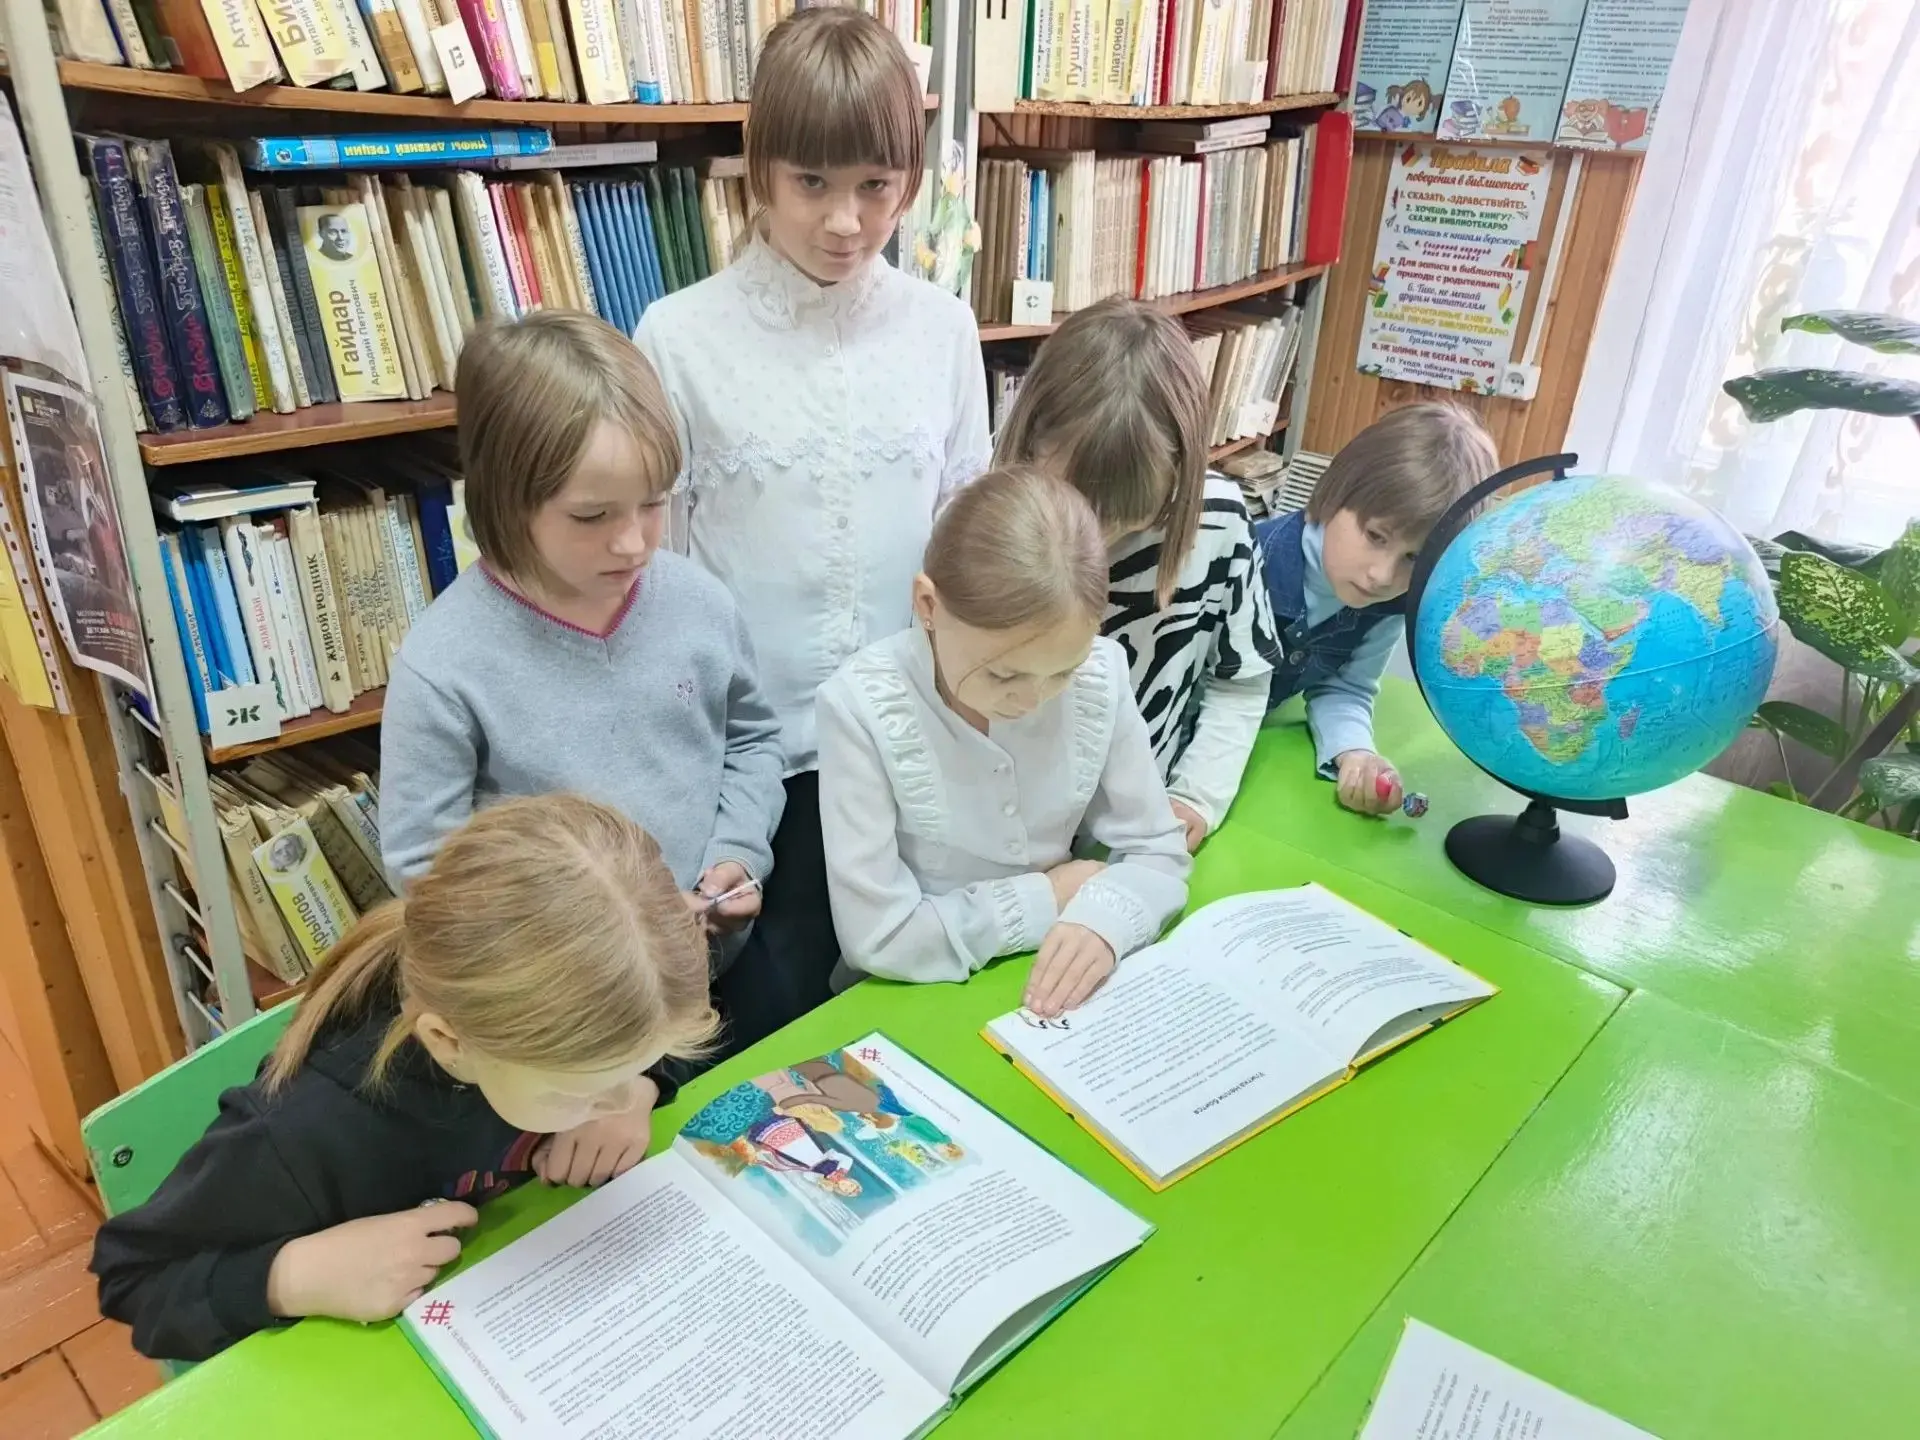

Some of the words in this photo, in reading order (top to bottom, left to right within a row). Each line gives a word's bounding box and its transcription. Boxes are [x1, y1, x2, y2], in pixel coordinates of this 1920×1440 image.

[270, 0, 307, 49] Би
[1066, 10, 1082, 85] Пушкин
[1108, 18, 1124, 83] Платонов
[344, 142, 390, 157] ГРЕЦИИ
[395, 139, 446, 155] ДРЕВНЕЙ
[451, 137, 487, 151] МИФЫ
[1405, 169, 1456, 186] поведения
[1465, 175, 1528, 190] библиотеке
[1406, 190, 1445, 201] СКАЗАТЬ
[1414, 204, 1448, 215] ХОЧЕШЬ
[1450, 208, 1476, 217] ВЗЯТЬ
[1407, 213, 1436, 223] СКАЖИ
[1439, 216, 1508, 230] БИБЛИОТЕКАРЮ
[1449, 231, 1482, 241] книгам
[1397, 256, 1417, 268] Для
[1418, 260, 1449, 271] записи
[1458, 264, 1514, 280] библиотеку
[1396, 269, 1434, 282] приходи
[1442, 275, 1500, 289] родителями
[349, 279, 370, 336] Петрович
[1430, 296, 1486, 310] читателям
[328, 290, 363, 378] Гайдар
[362, 335, 380, 386] Аркадий
[1470, 357, 1495, 369] СОРИ
[306, 553, 327, 610] РОДНИК
[318, 612, 338, 662] ЖИВОЙ
[330, 671, 340, 682] 4
[227, 704, 261, 726] Ж
[292, 892, 331, 956] Крылов
